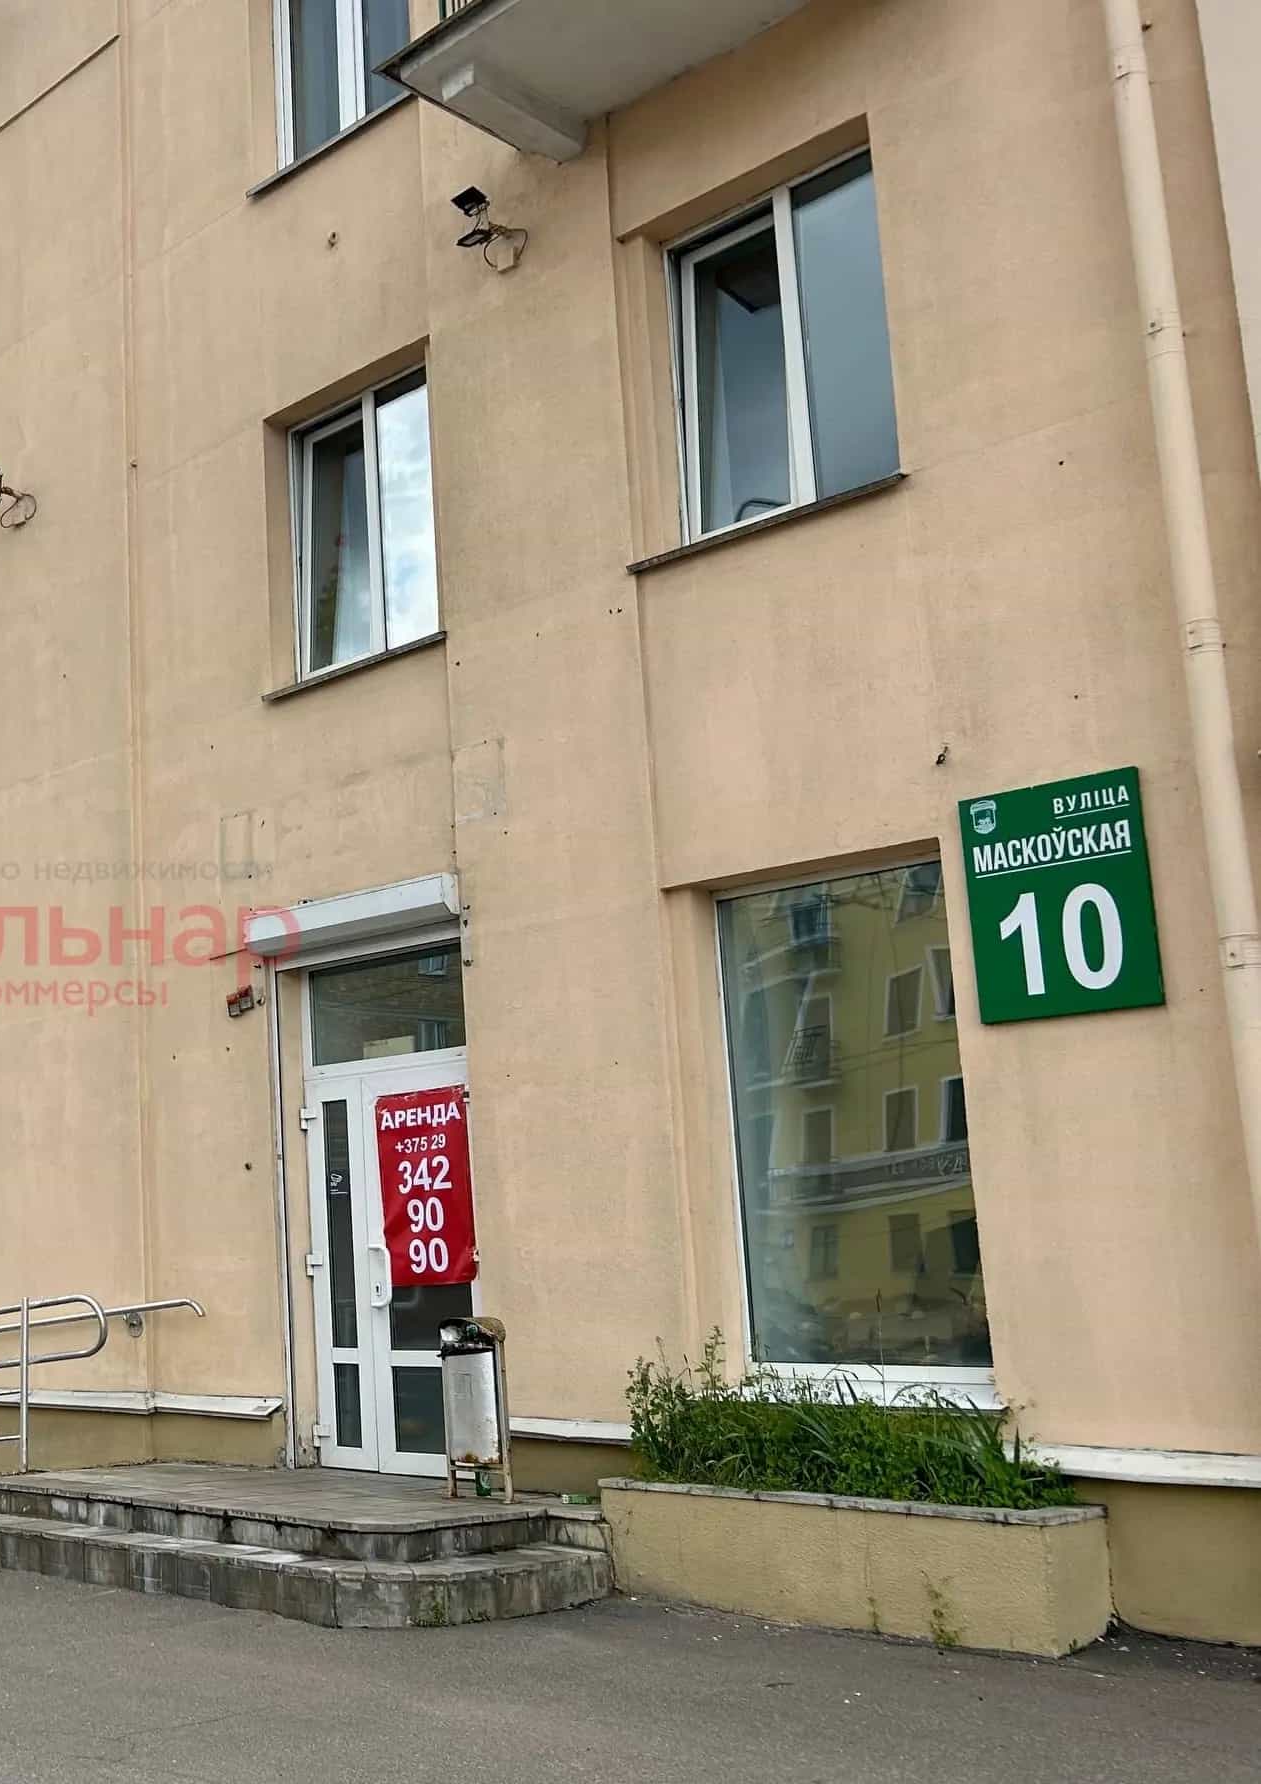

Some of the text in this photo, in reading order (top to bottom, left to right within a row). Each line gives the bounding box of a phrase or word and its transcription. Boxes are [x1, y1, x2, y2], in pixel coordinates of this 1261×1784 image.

[1053, 785, 1128, 813] ВУЛІЦА
[973, 819, 1130, 871] МАСКОЎСКАЯ
[999, 883, 1122, 994] 10
[380, 1101, 460, 1129] АРЕНДА
[395, 1133, 445, 1152] +375 29
[398, 1155, 451, 1193] 342
[407, 1197, 443, 1232] 90
[409, 1237, 447, 1273] 90
